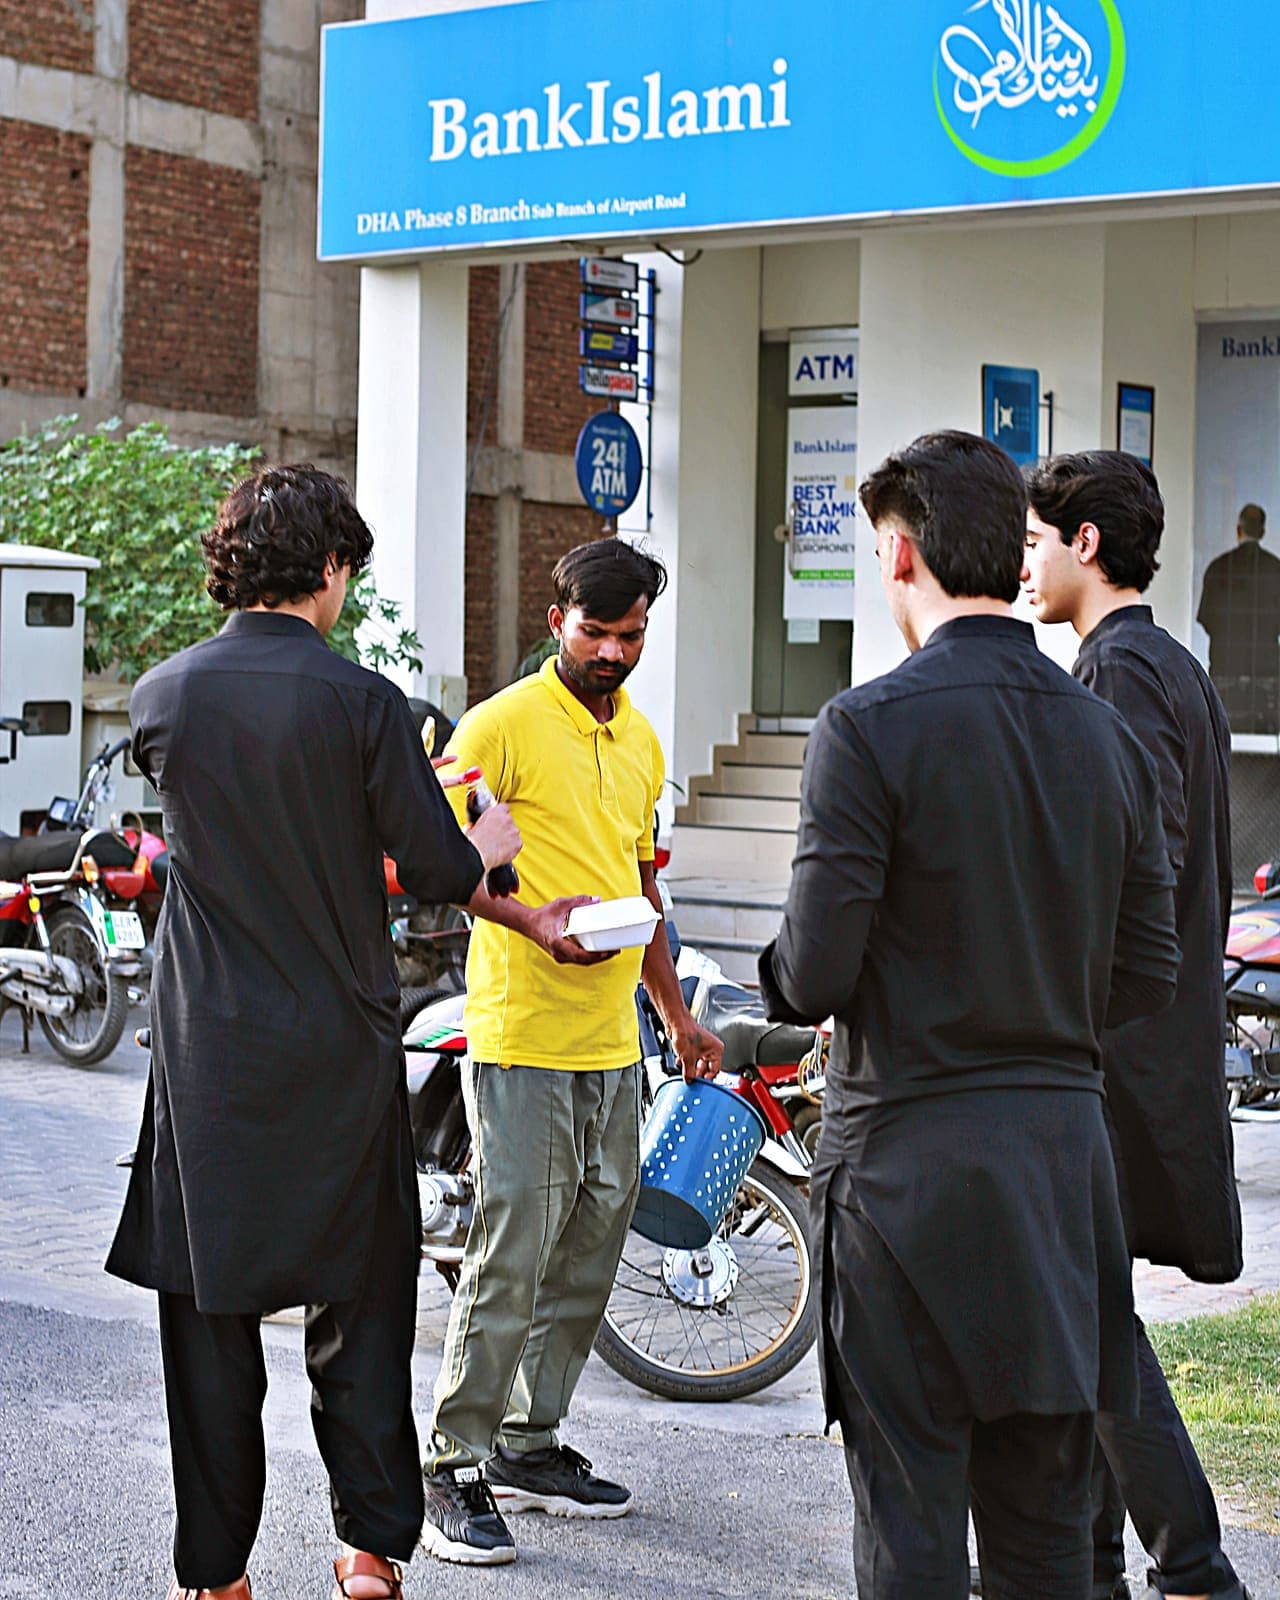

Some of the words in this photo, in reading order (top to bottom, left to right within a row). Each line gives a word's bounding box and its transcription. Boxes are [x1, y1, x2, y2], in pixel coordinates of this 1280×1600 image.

[428, 57, 791, 162] BankIslami
[357, 211, 400, 234] DHA
[404, 208, 453, 230] Phase
[456, 205, 467, 226] 8
[470, 199, 530, 224] Branch
[532, 202, 554, 219] Sub
[556, 200, 595, 218] Branch
[597, 198, 610, 214] of
[611, 197, 653, 217] Airport
[655, 192, 686, 210] Road
[795, 354, 854, 381] ATM
[591, 467, 627, 497] ATM
[793, 485, 837, 501] BEST
[793, 520, 841, 536] BANK
